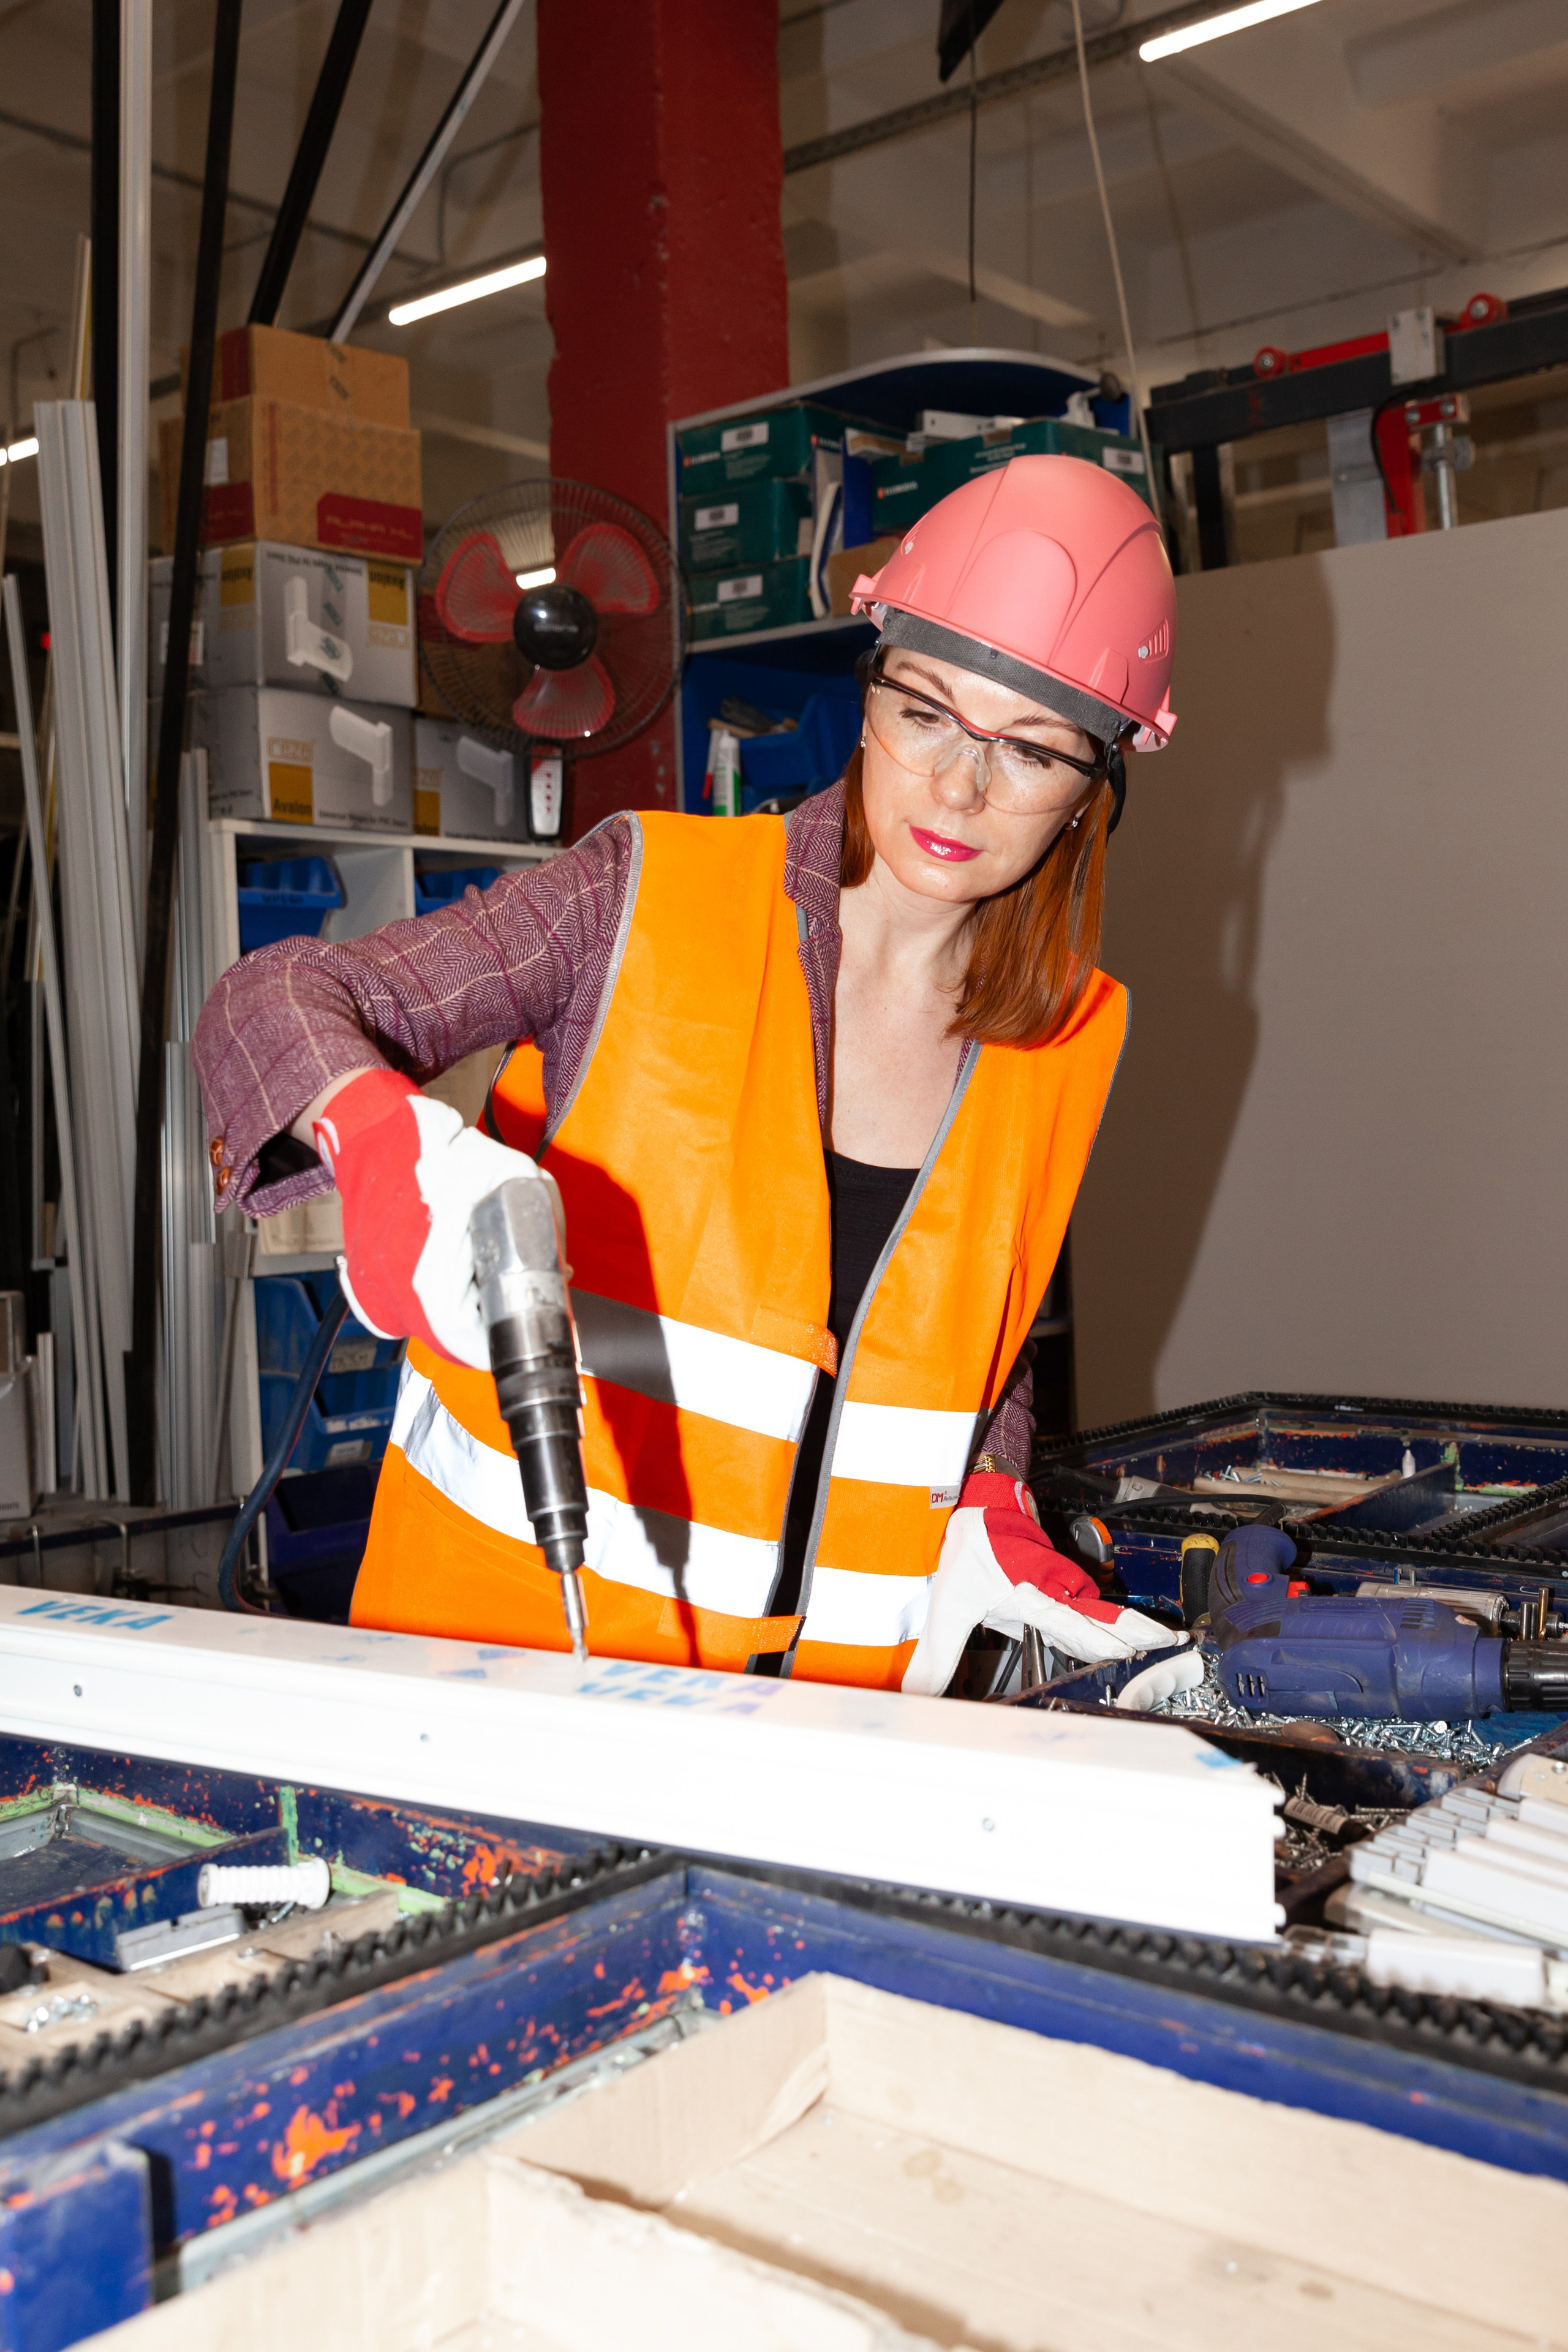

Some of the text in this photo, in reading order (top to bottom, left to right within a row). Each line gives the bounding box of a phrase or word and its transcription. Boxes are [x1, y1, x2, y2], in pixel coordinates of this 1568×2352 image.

[273, 797, 312, 816] Avalon
[15, 1600, 173, 1630] VEKA
[601, 1664, 786, 1697] VEKA
